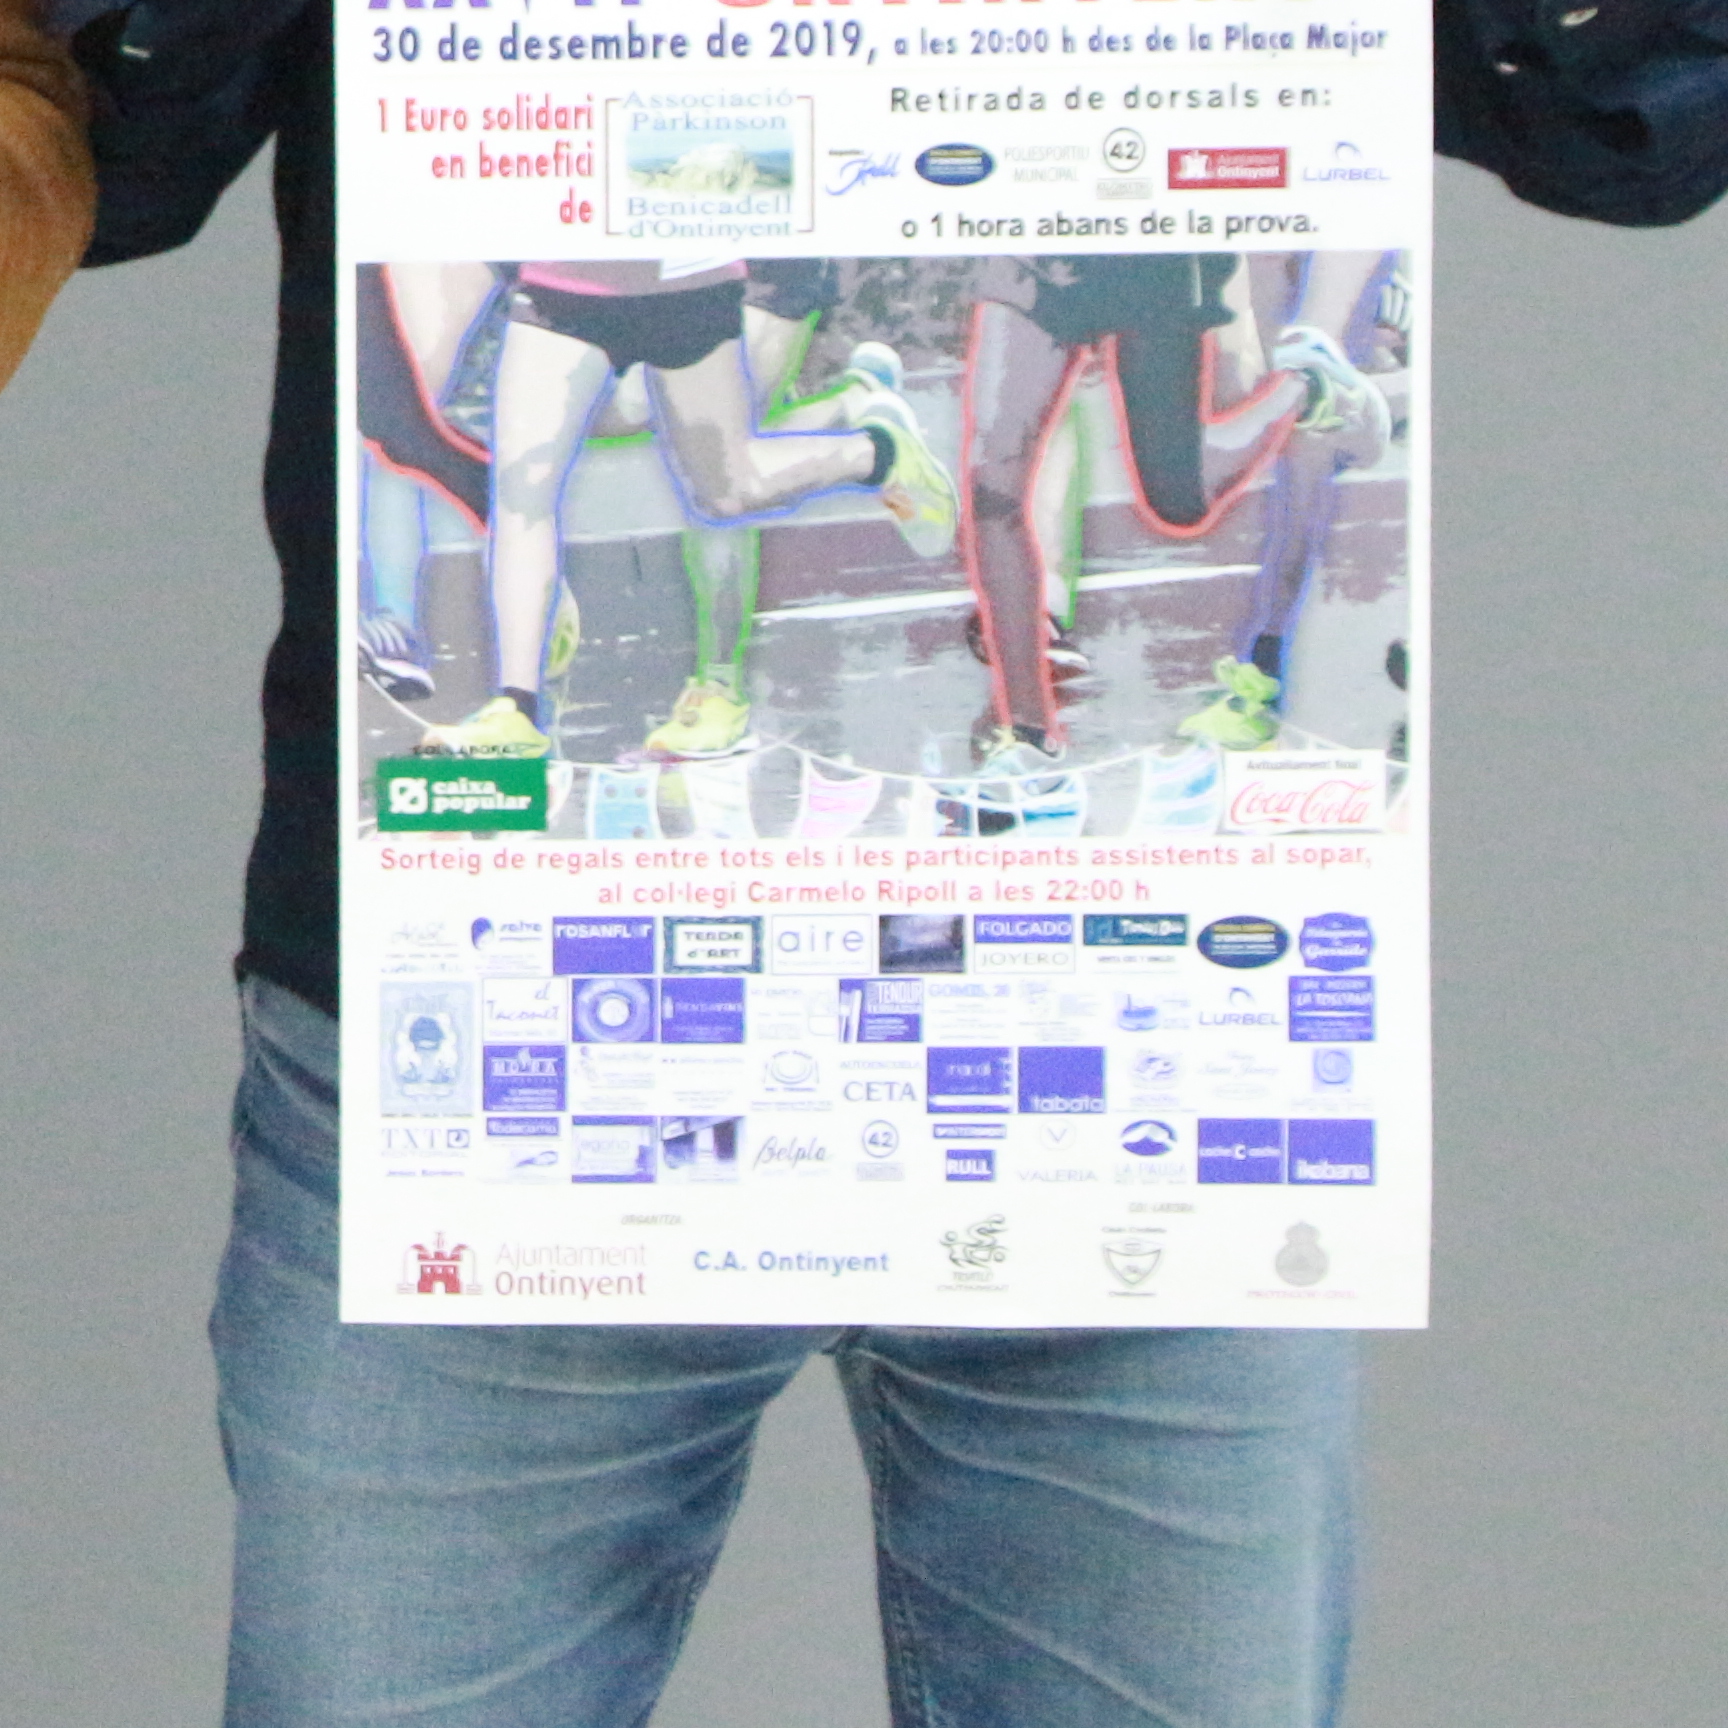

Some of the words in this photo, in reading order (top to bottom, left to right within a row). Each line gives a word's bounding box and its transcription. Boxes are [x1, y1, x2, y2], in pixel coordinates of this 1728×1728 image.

[373, 26, 420, 62] 30
[437, 22, 481, 62] de
[498, 20, 688, 60] desembre
[706, 18, 750, 58] de
[769, 19, 876, 64] 2019,
[894, 38, 908, 56] a
[920, 27, 956, 54] les
[970, 28, 1048, 54] 20:00
[1062, 26, 1075, 53] h
[1088, 25, 1132, 52] des
[1145, 25, 1176, 52] de
[1188, 24, 1212, 50] la
[1224, 21, 1294, 59] Plaça
[1306, 21, 1386, 56] Major
[378, 98, 386, 132] 1
[404, 98, 468, 132] Euro
[482, 93, 592, 130] solidari
[890, 86, 1045, 112] Retirada
[1064, 86, 1104, 110] de
[1123, 82, 1258, 110] dorsals
[1277, 88, 1330, 107] en:
[431, 155, 464, 178] en
[478, 140, 592, 178] benefici
[558, 187, 592, 224] de
[900, 219, 918, 238] o
[930, 212, 942, 236] 1
[957, 212, 1024, 238] hora
[1036, 211, 1128, 236] abans
[1140, 211, 1175, 234] de
[1188, 209, 1213, 234] la
[1224, 214, 1317, 240] prova.
